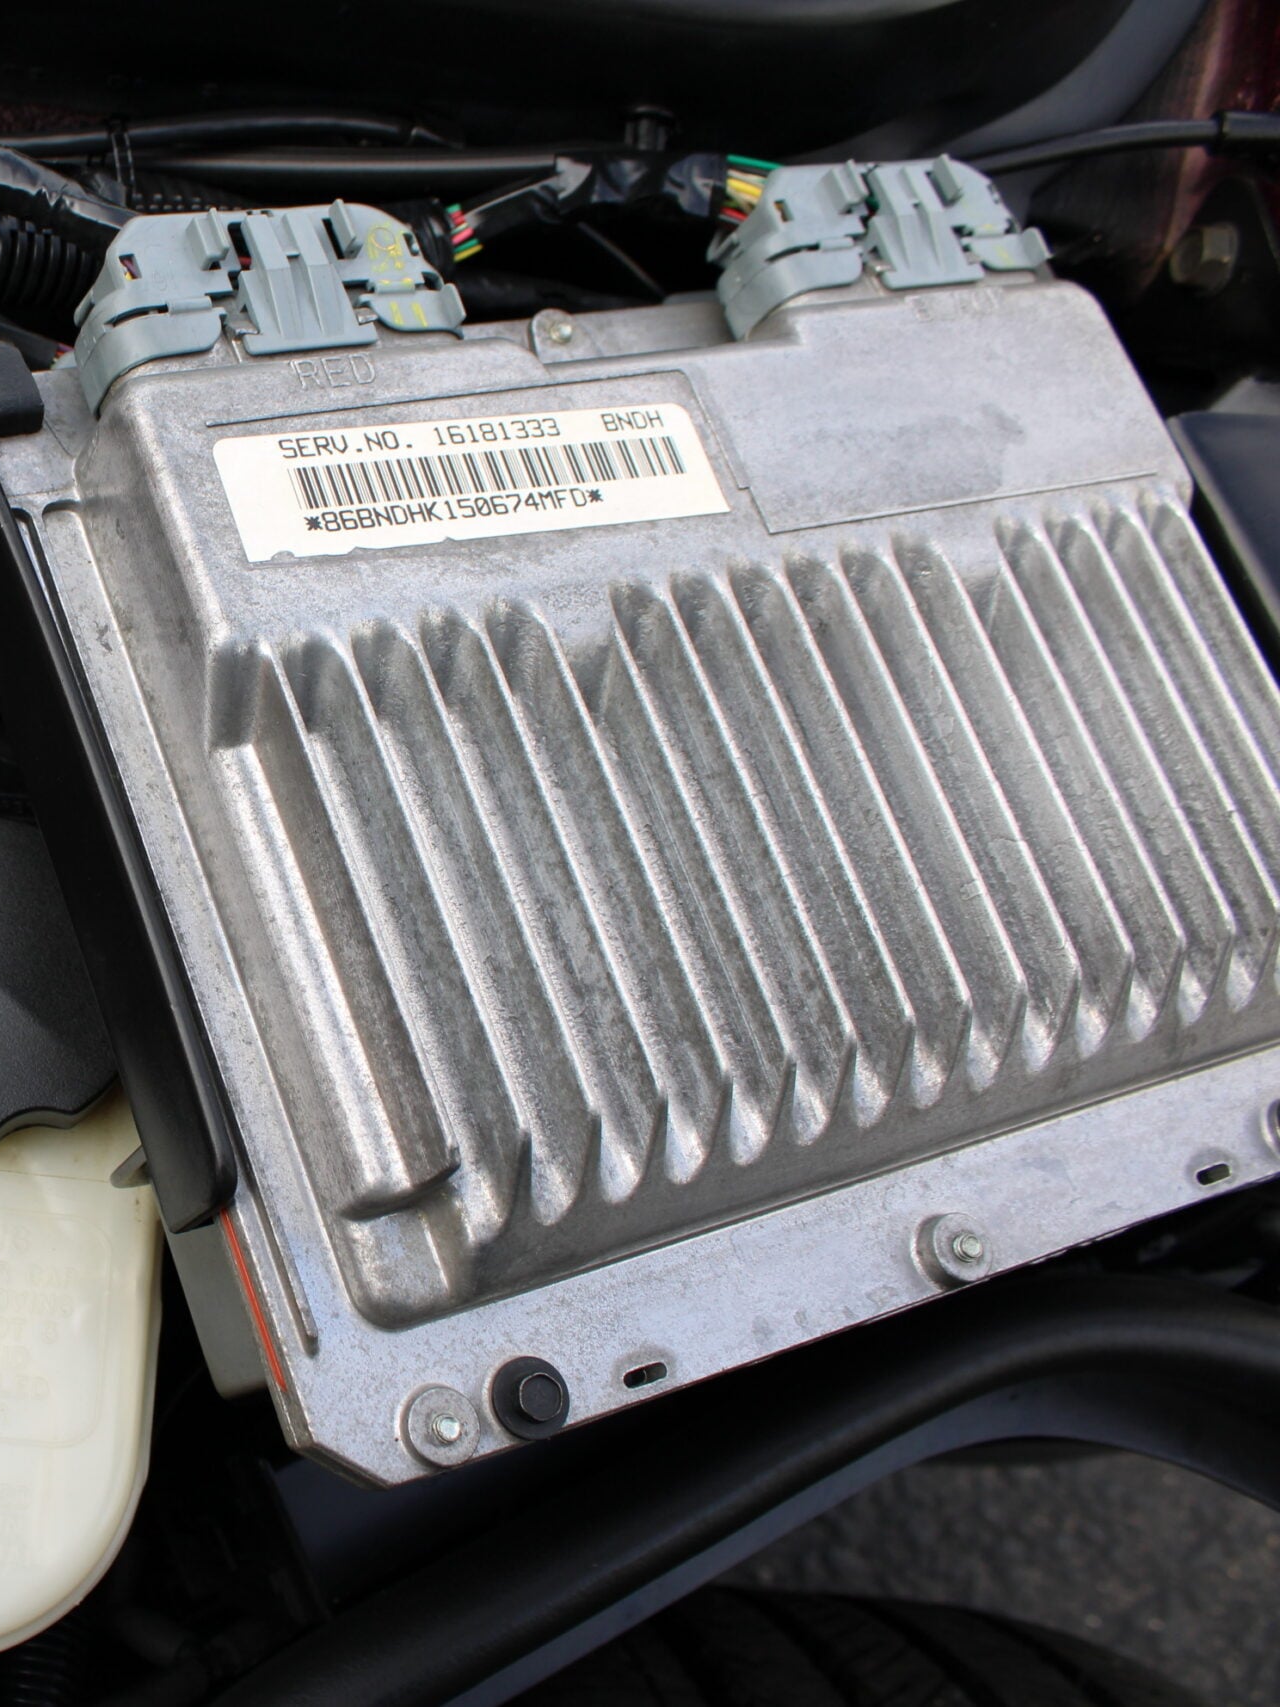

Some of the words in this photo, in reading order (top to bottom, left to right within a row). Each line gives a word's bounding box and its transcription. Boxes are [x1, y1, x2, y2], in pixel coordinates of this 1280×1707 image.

[288, 351, 377, 390] RED
[277, 431, 414, 459] SERV.NO.
[433, 418, 561, 447] 16181333
[601, 410, 664, 433] BNDH
